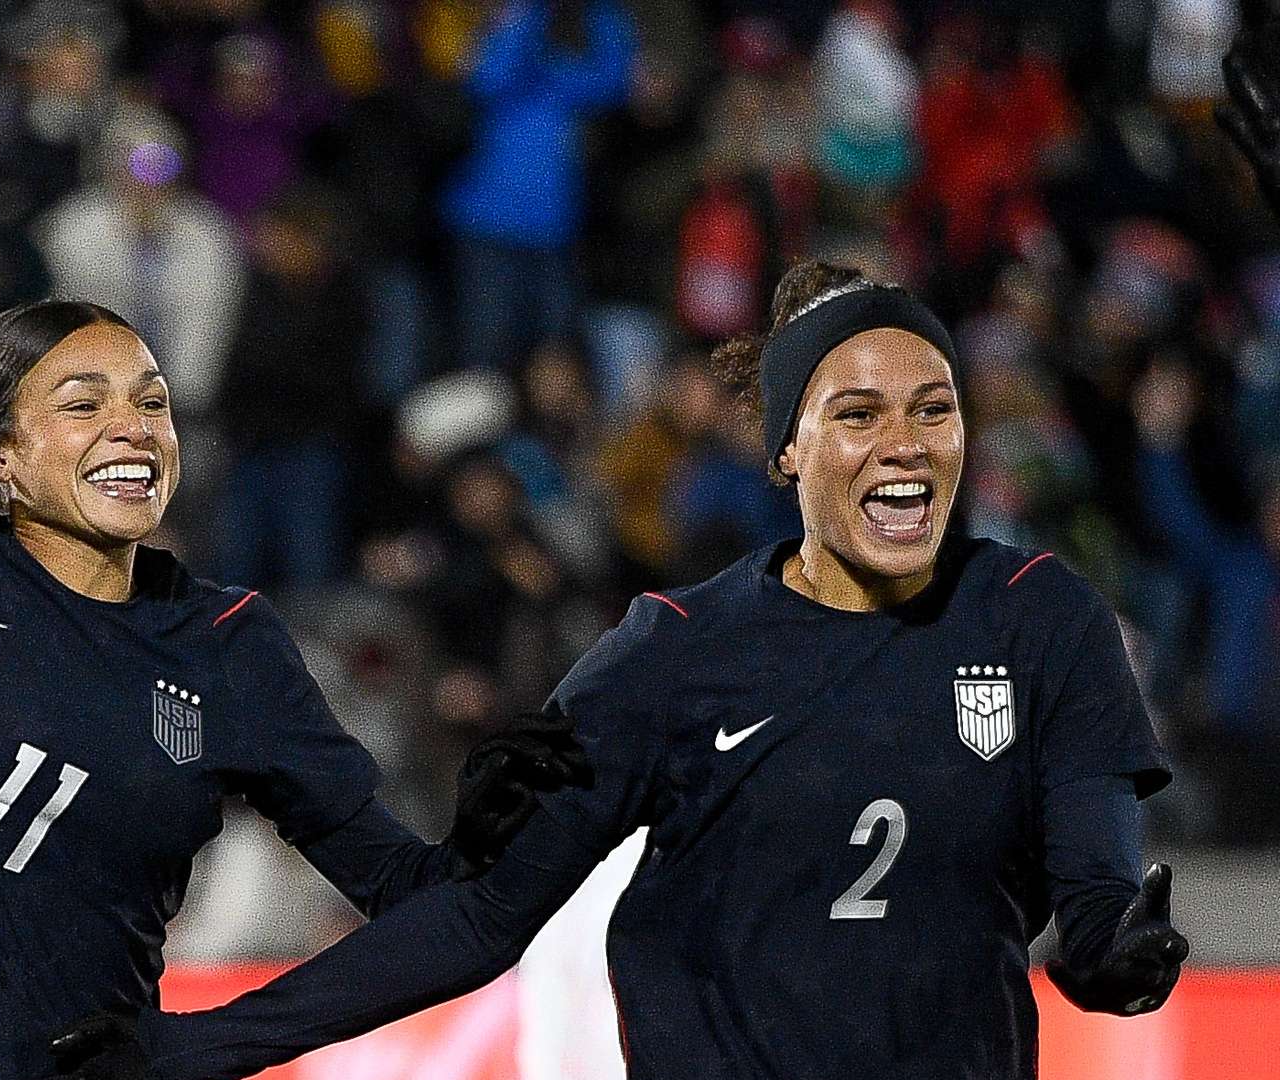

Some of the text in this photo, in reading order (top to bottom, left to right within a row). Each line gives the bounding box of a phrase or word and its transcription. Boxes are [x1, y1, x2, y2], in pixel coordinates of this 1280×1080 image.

[158, 696, 197, 728] USA
[959, 685, 1007, 716] USA
[830, 798, 906, 920] 2
